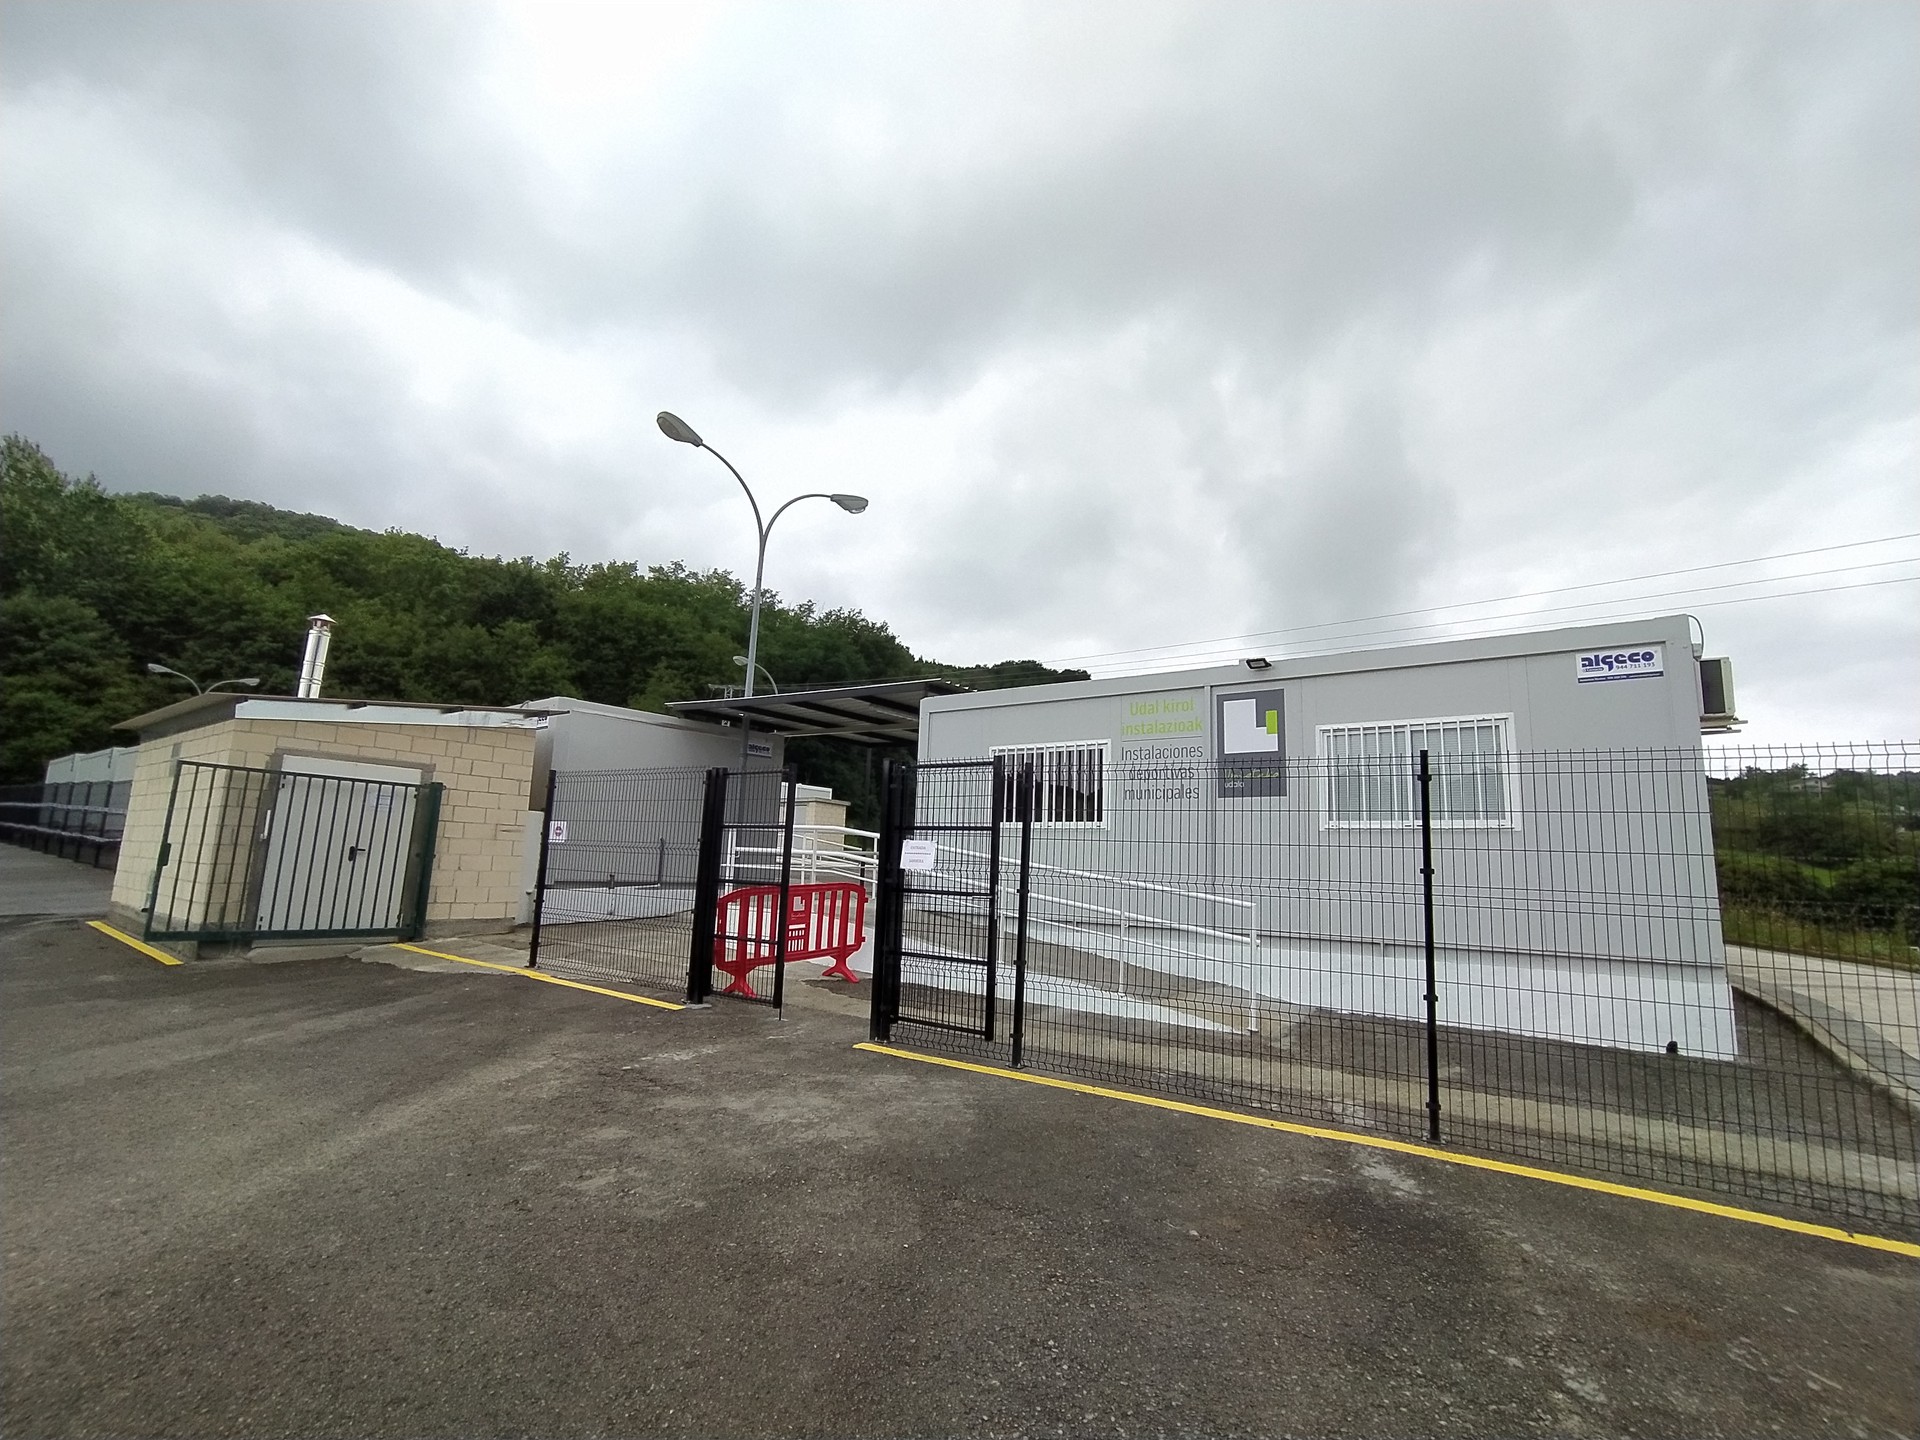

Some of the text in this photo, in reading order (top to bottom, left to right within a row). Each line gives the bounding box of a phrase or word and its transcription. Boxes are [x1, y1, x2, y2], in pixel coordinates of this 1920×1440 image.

[1580, 651, 1655, 672] algeco
[1130, 697, 1194, 716] Udal kirol
[1121, 718, 1203, 735] instalazioak
[1121, 743, 1203, 761] Instalaciones
[1129, 765, 1195, 783] deportivas
[1124, 783, 1200, 803] municipales
